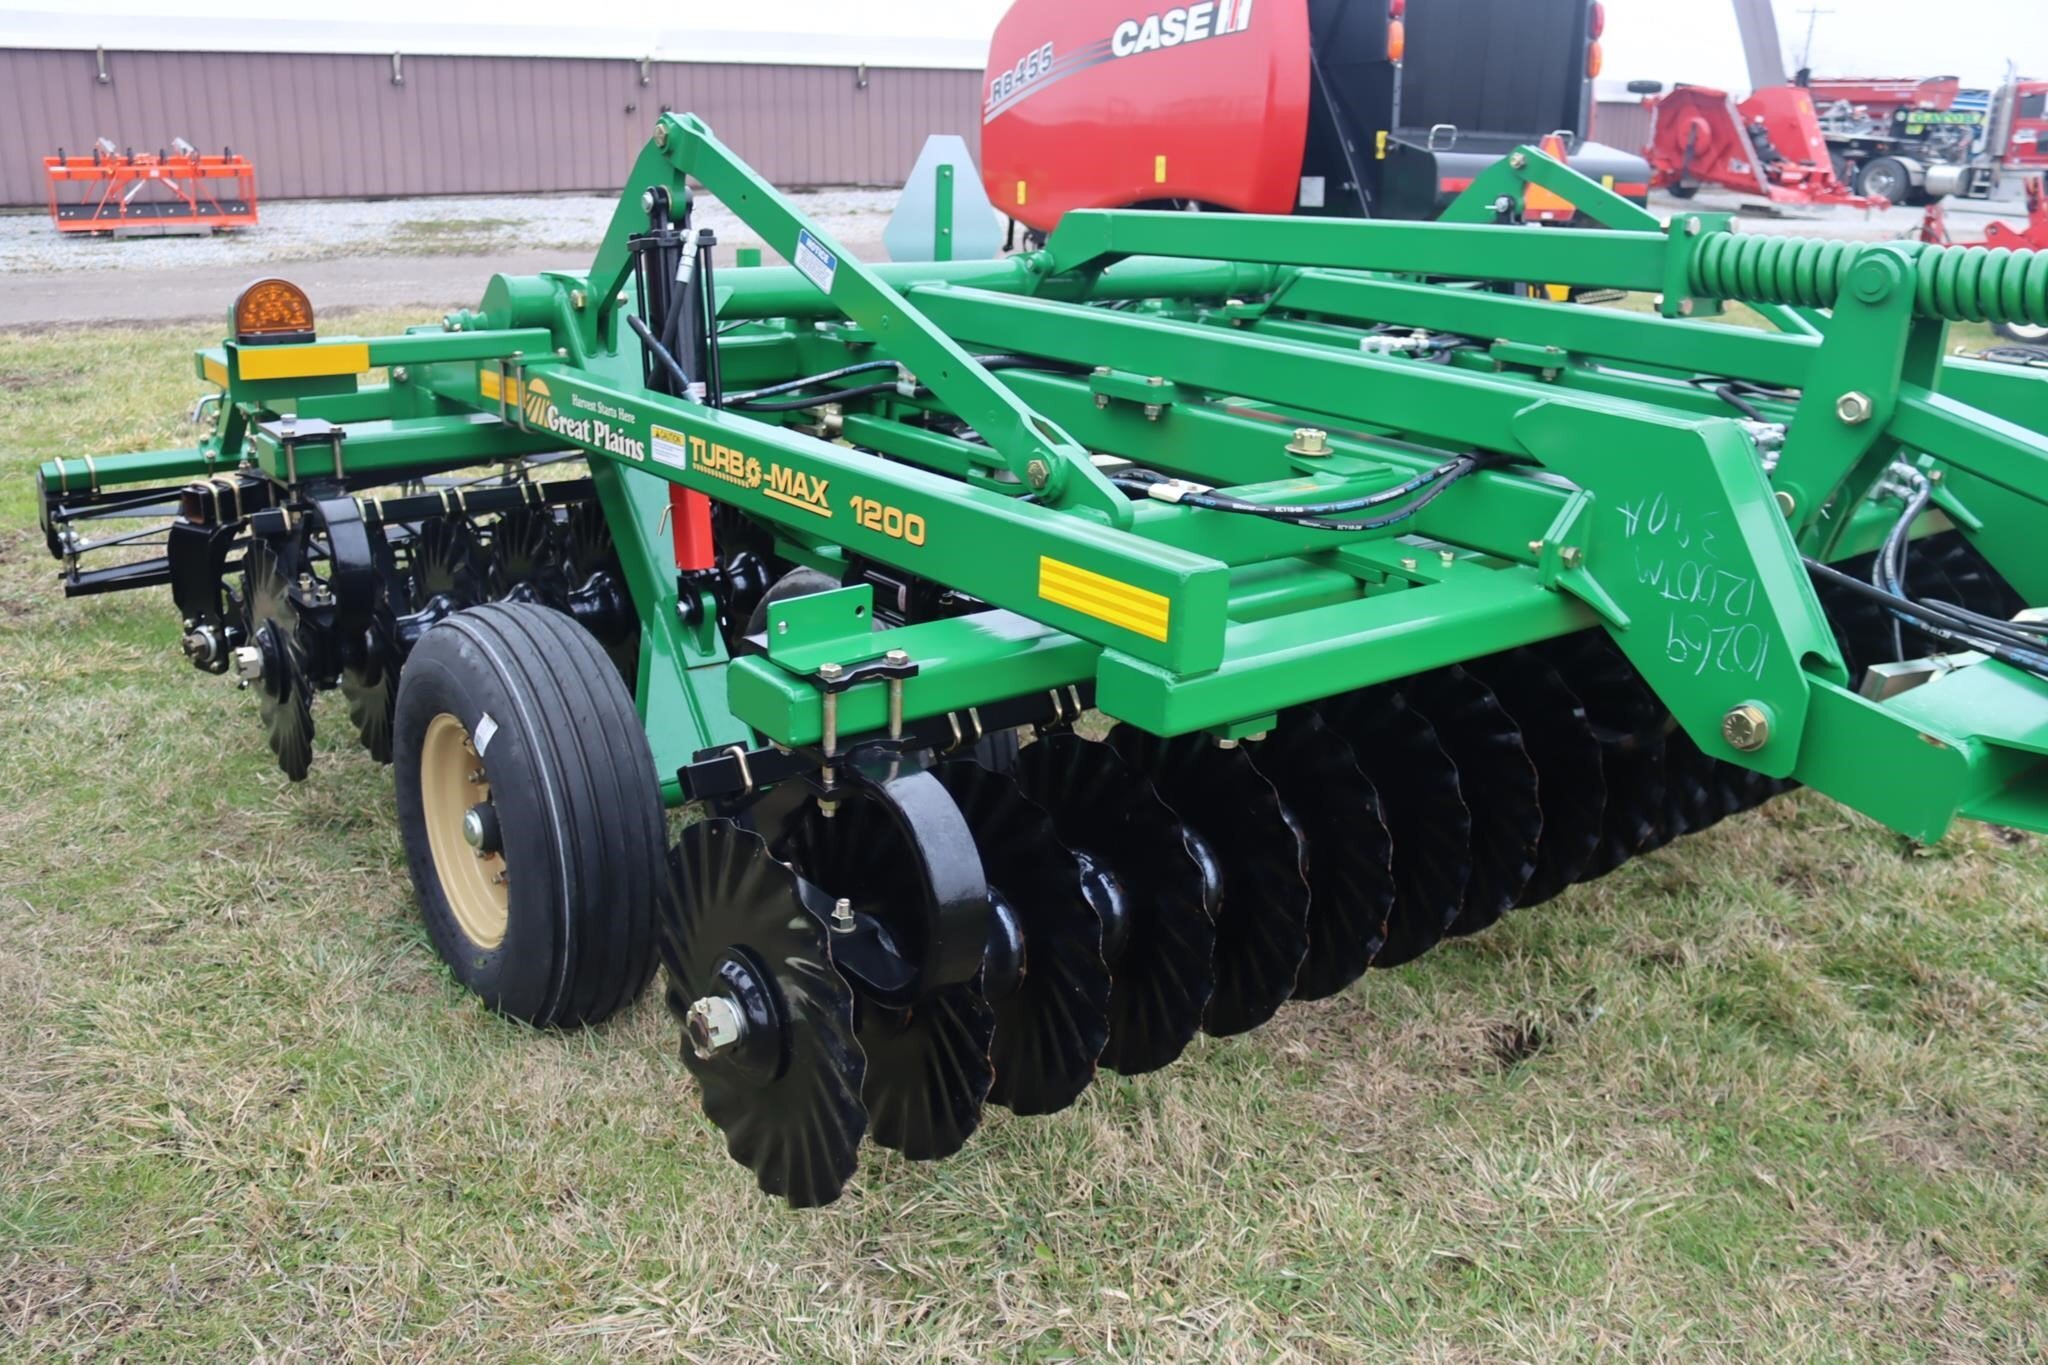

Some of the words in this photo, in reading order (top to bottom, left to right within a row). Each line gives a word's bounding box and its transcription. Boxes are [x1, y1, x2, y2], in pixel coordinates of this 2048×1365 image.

[1111, 2, 1213, 57] CASE
[990, 41, 1054, 104] RB455
[547, 405, 592, 443] Great
[593, 419, 645, 462] Plains
[571, 393, 597, 412] Harvest
[597, 401, 617, 419] Starts
[849, 495, 926, 547] 1200
